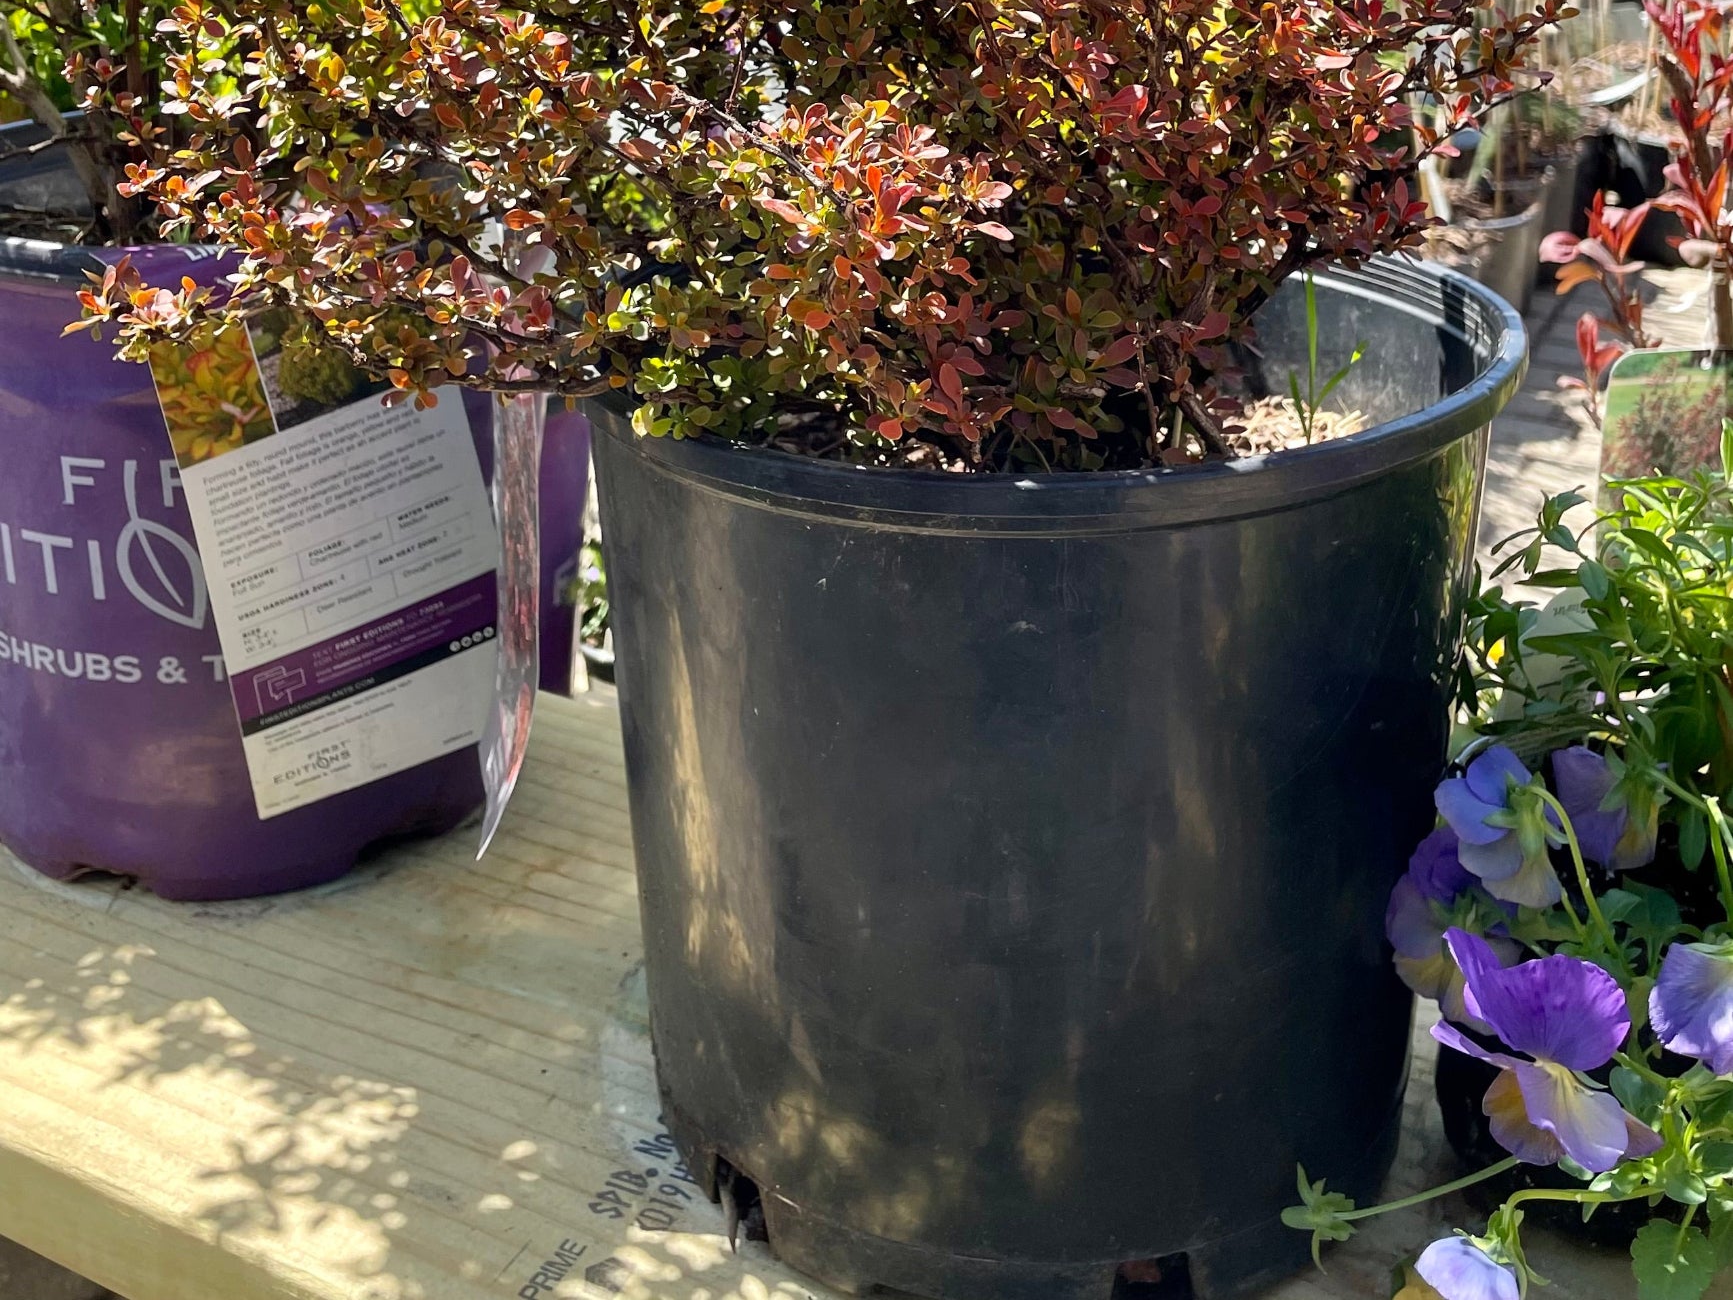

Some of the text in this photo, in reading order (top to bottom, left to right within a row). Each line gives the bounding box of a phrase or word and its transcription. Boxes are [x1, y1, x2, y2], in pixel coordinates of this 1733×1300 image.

[203, 467, 236, 486] Forming
[397, 506, 422, 521] WATER
[308, 538, 345, 558] FOLIAGE:
[230, 565, 278, 589] EXPOSURE:
[238, 608, 260, 622] USDA
[263, 588, 309, 612] HARDINESS
[335, 634, 360, 651] FIRST
[362, 616, 403, 639] EDITIONS
[156, 656, 188, 684] &
[518, 1238, 588, 1300] PRIME
